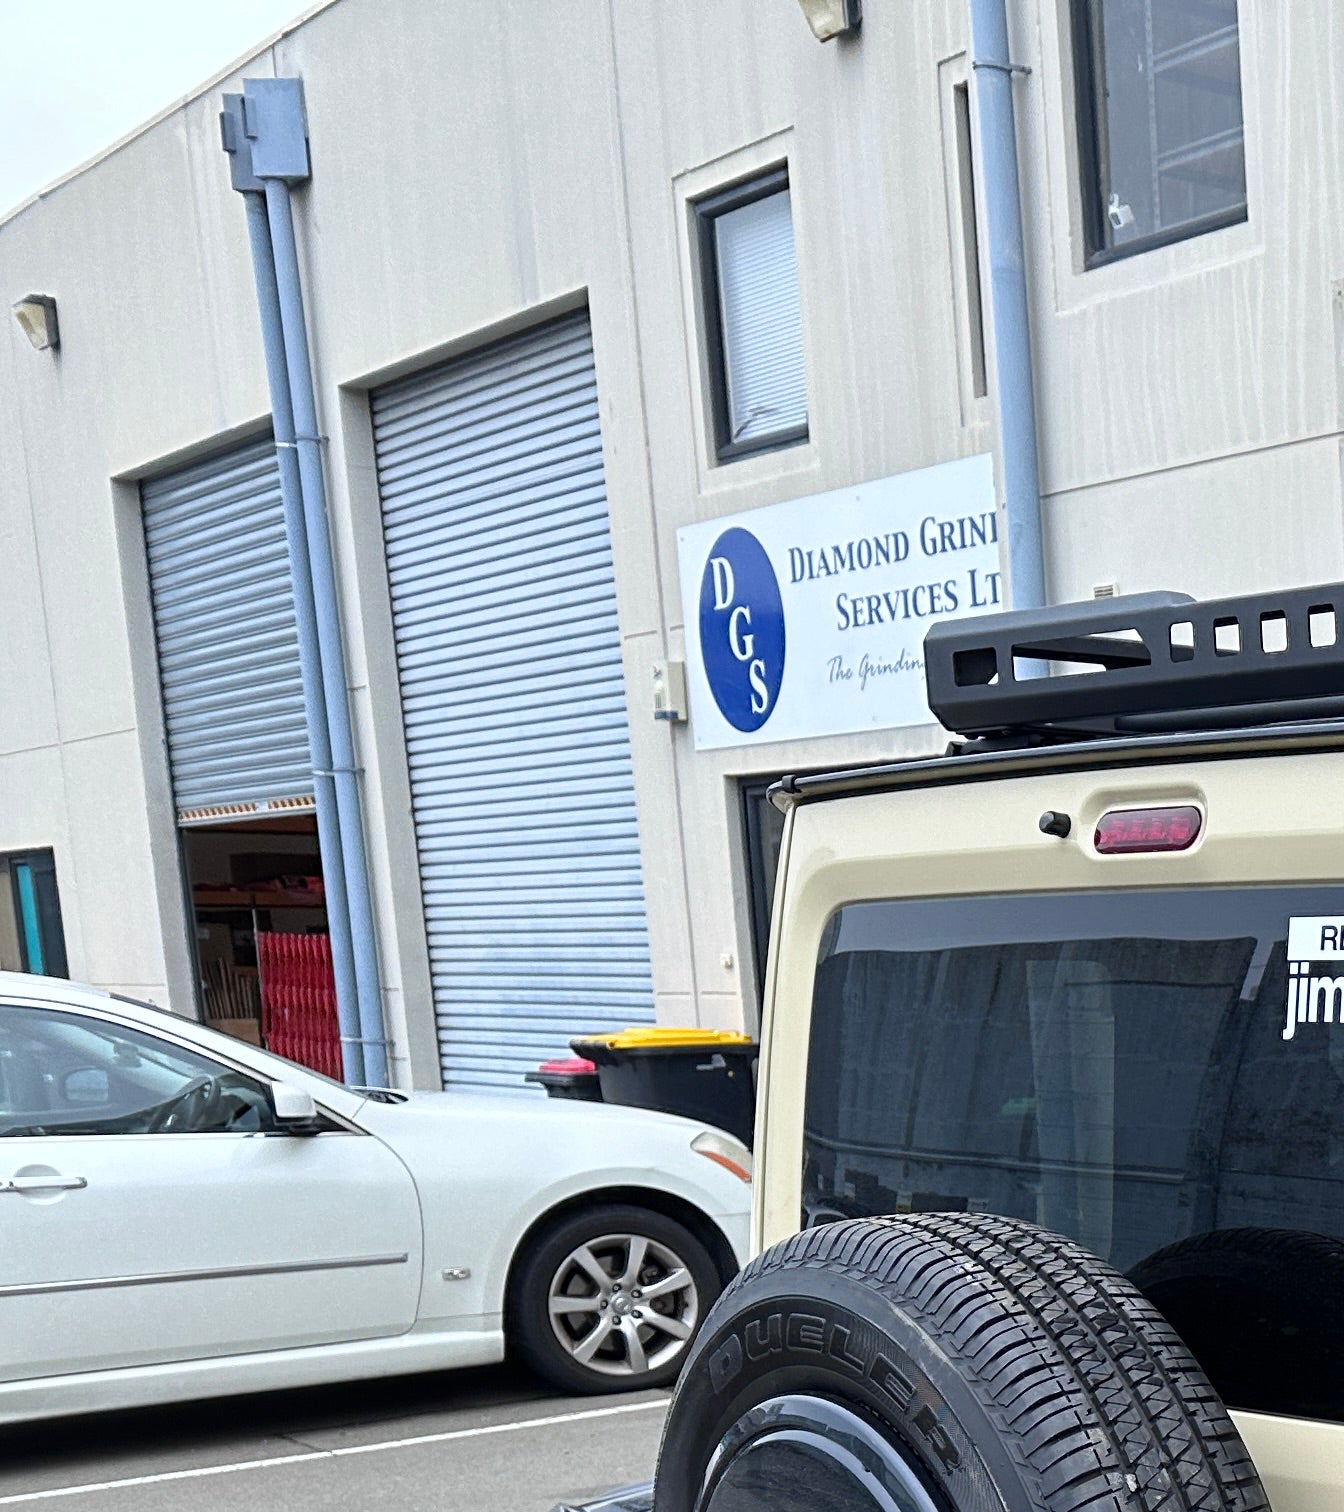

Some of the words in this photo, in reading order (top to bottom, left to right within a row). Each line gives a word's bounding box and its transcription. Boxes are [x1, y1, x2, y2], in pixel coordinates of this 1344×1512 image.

[788, 531, 909, 583] DIAMOND
[836, 579, 958, 631] SERVICES
[826, 654, 853, 684] The
[858, 647, 926, 691] Grindin
[707, 1312, 965, 1476] DUELER
